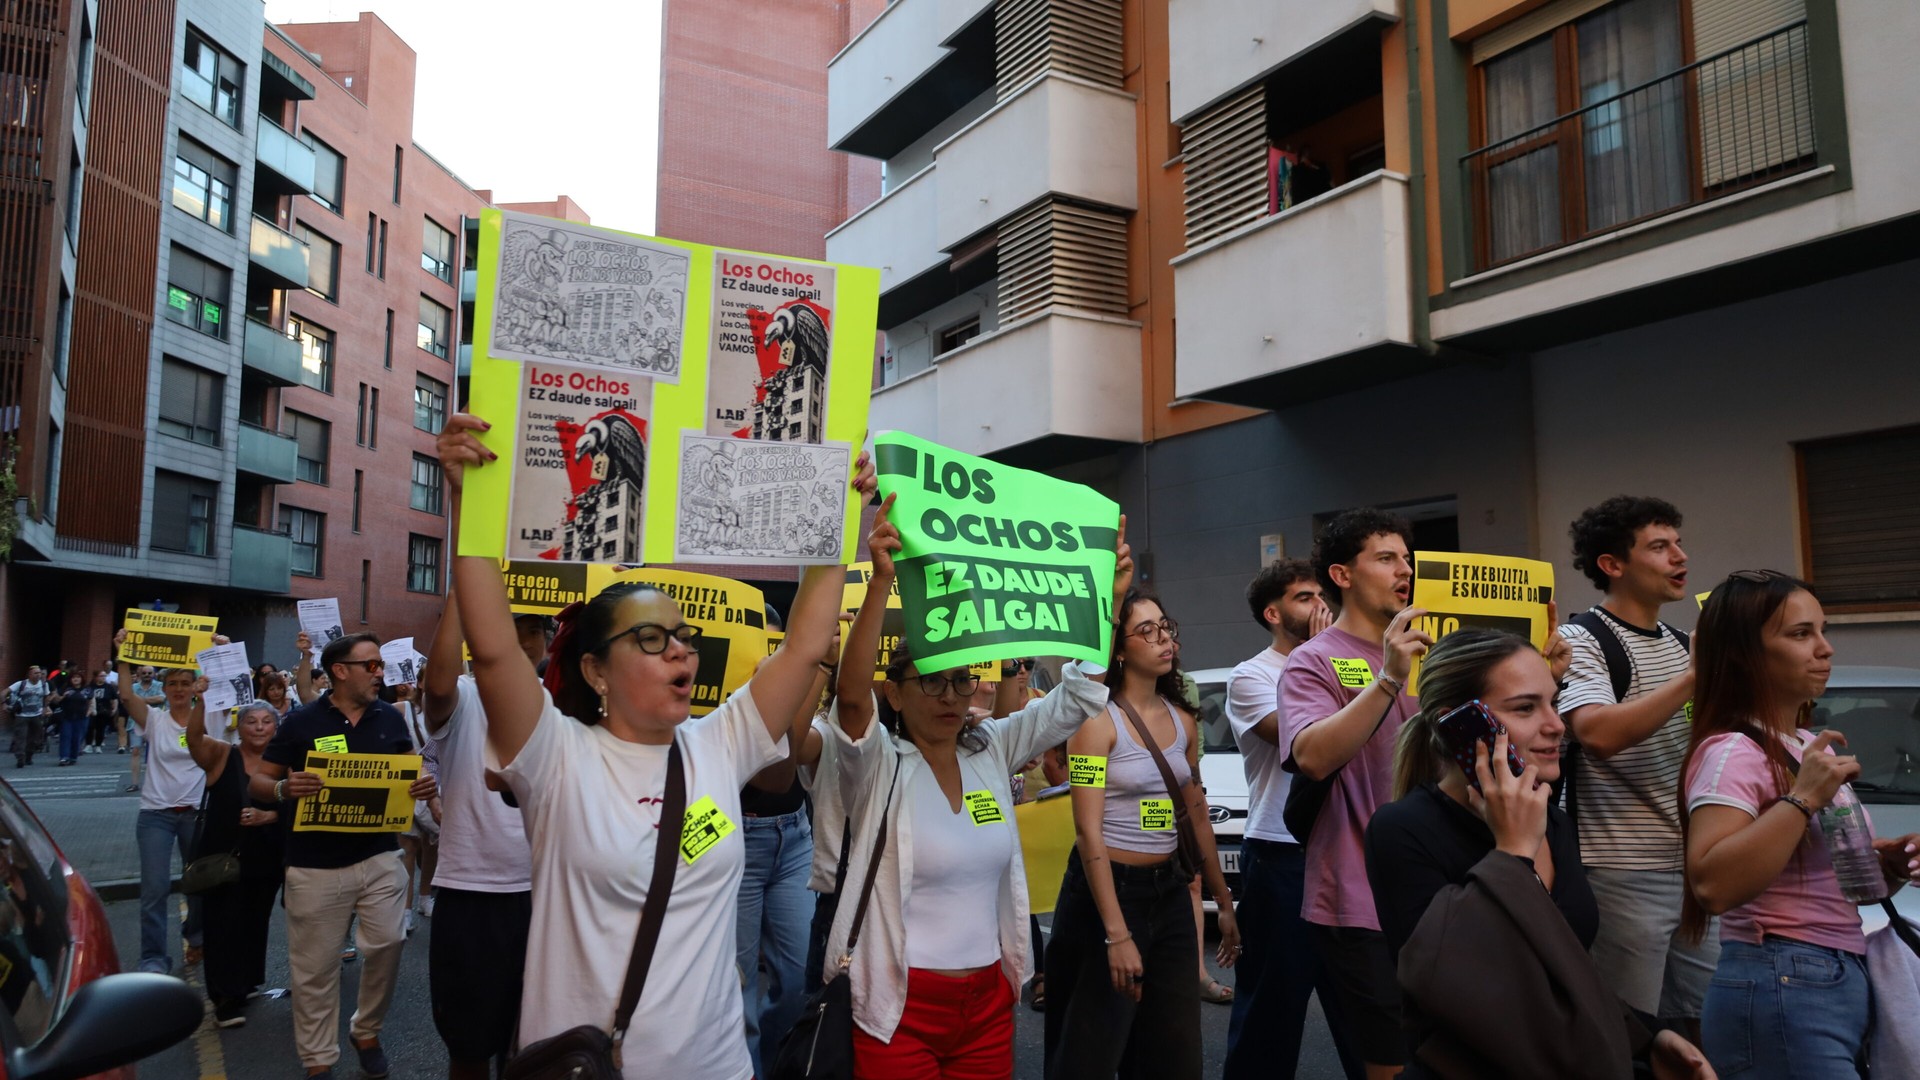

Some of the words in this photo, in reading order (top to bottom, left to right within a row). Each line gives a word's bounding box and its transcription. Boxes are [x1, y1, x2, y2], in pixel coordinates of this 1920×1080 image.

[567, 250, 595, 266] LOS
[600, 252, 649, 270] OCHOS
[592, 268, 612, 281] NOS
[722, 259, 753, 278] Los
[757, 264, 814, 287] Ochos
[722, 278, 736, 289] EZ
[739, 280, 779, 295] daude
[782, 287, 821, 300] salgai!
[736, 301, 764, 311] vecinos
[727, 311, 754, 320] vecinas
[720, 320, 733, 328] Los
[735, 320, 758, 331] Ochos
[719, 333, 738, 343] ¡NO
[740, 335, 760, 345] NOS
[719, 343, 758, 354] VAMOS!
[531, 367, 564, 388] Los
[568, 372, 630, 395] Ochos
[529, 388, 545, 400] EZ
[549, 390, 591, 405] daude
[594, 396, 637, 411] salgai!
[528, 411, 542, 419] Los
[544, 412, 575, 422] vecinos
[717, 408, 745, 421] LAB
[526, 434, 540, 442] Los
[542, 435, 568, 444] Ochos
[525, 447, 546, 457] ¡NO
[548, 448, 571, 459] NOS
[737, 454, 763, 471] LOS
[766, 452, 813, 469] OCHOS
[760, 469, 779, 481] NOS
[923, 452, 996, 505] LOS
[521, 528, 553, 541] LAB
[920, 507, 1080, 553] OCHOS
[924, 560, 975, 600] EZ
[975, 563, 1091, 599] DAUDE
[1452, 564, 1529, 585] ETXEBIZITZA
[522, 587, 584, 604] VIVIENDA
[1451, 581, 1523, 601] ESKUBIDEA
[1527, 587, 1538, 603] DA
[143, 614, 191, 624] ETXEBIZITZA
[724, 608, 743, 624] DA
[924, 598, 1070, 643] SALGAI
[141, 620, 184, 630] ESKUBIDEA
[1423, 615, 1460, 644] NO
[126, 632, 145, 644] NO
[137, 645, 172, 654] NEGOCIO
[136, 651, 146, 659] LA
[149, 653, 186, 663] VIVIENDA
[329, 760, 390, 770] ETXEBIZITZA
[327, 769, 382, 779] ESKUBIDEA
[387, 771, 399, 779] DA
[303, 804, 315, 813] AL
[320, 804, 365, 814] NEGOCIO
[301, 812, 314, 822] DE
[318, 813, 331, 822] LA
[336, 814, 383, 824] VIVIENDA
[385, 816, 407, 825] LAB
[682, 812, 711, 839] OCHOS
